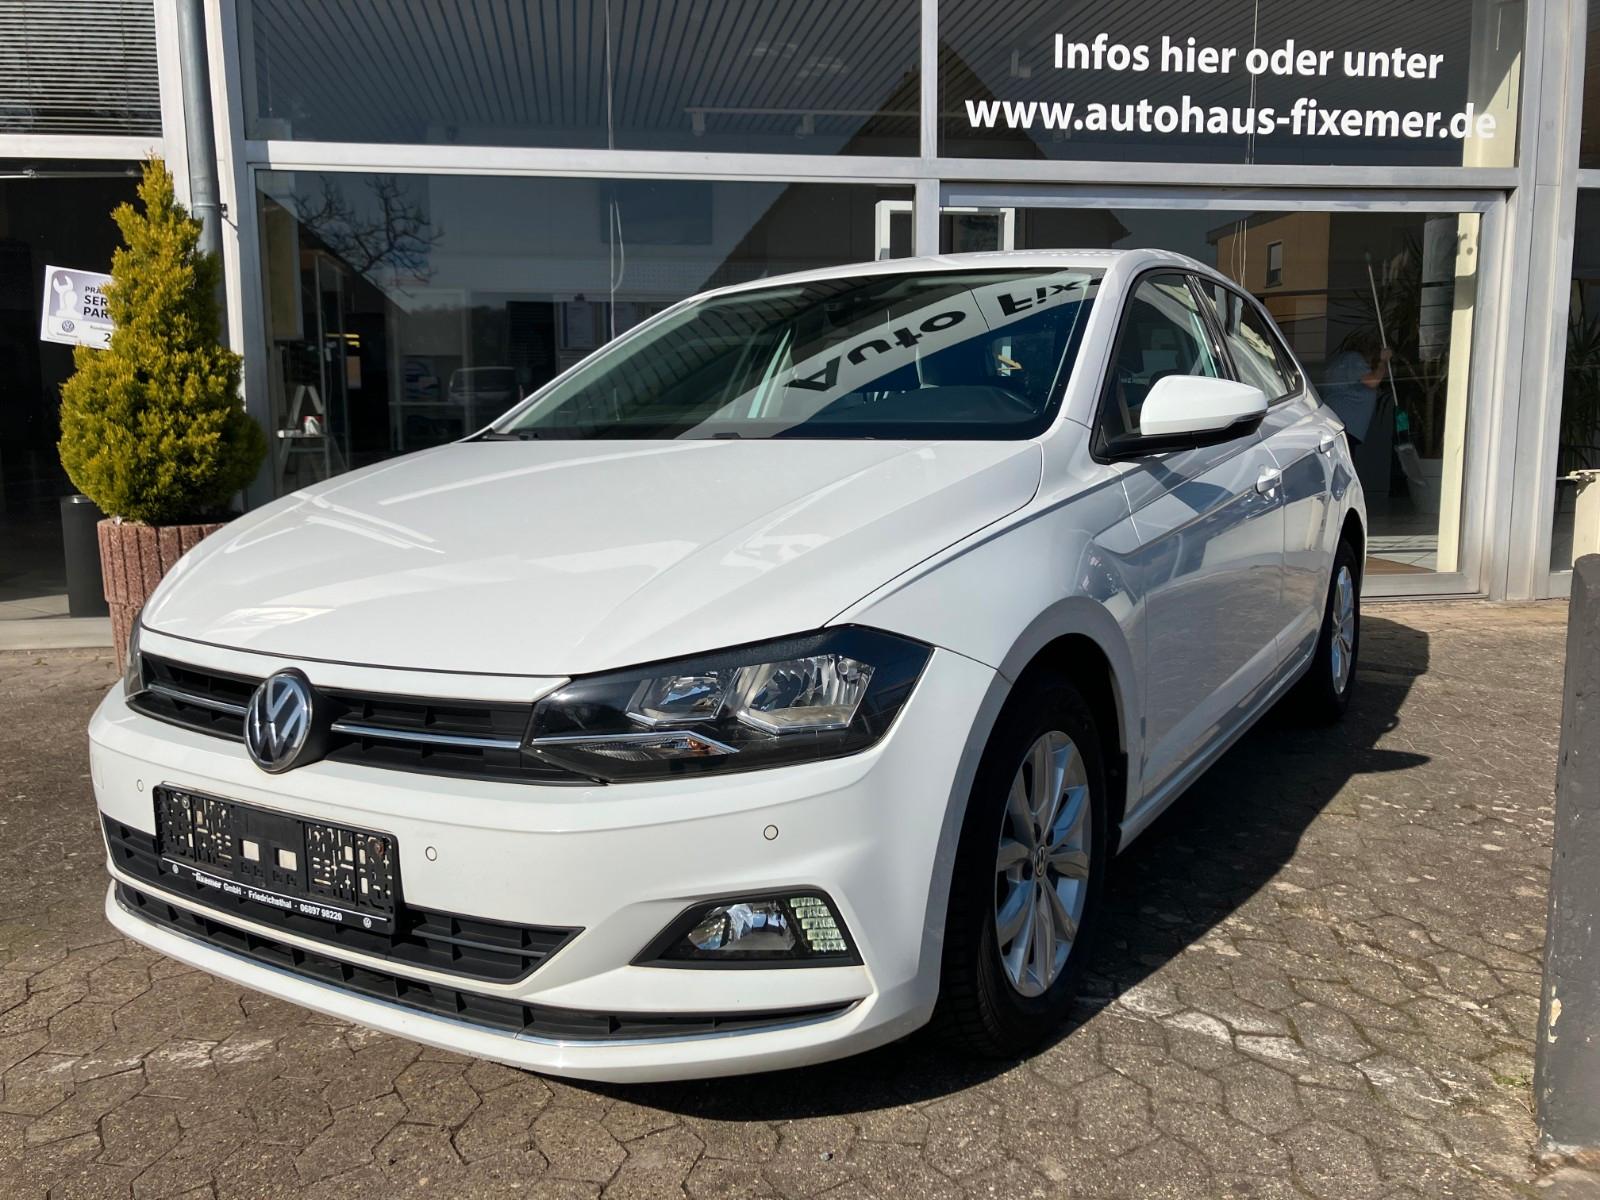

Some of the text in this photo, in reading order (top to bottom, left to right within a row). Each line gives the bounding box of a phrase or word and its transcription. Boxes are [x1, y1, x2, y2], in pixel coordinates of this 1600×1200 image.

[1053, 33, 1444, 79] Infos hier oder unter
[965, 95, 1496, 140] www.autohaus-fixemer.de
[84, 295, 109, 307] SER
[83, 306, 109, 319] PAR
[103, 333, 112, 343] 2
[223, 882, 242, 896] GmbH
